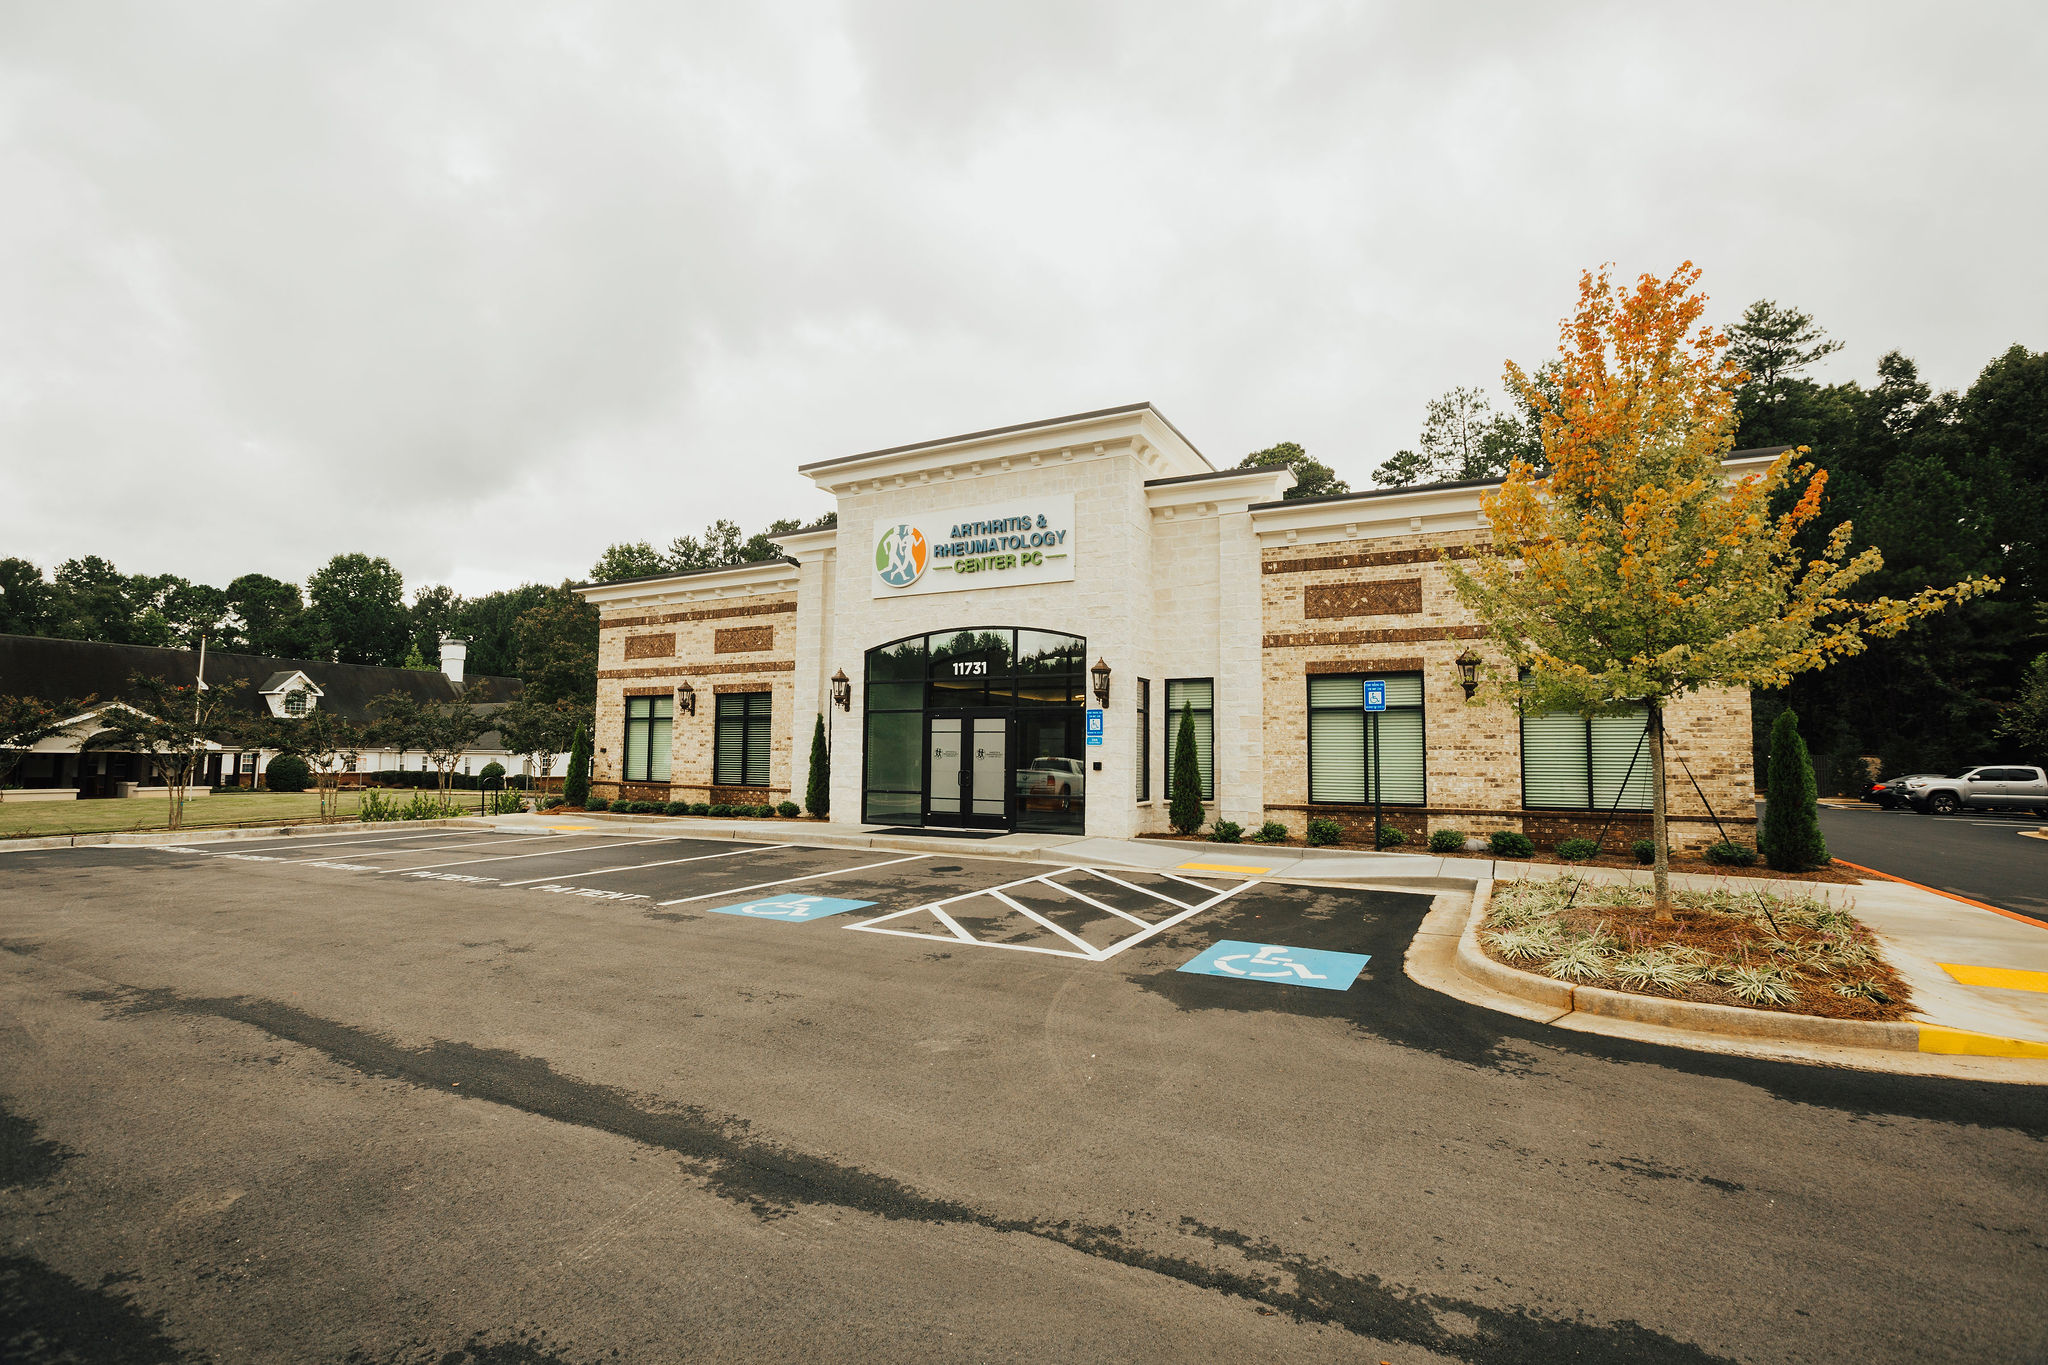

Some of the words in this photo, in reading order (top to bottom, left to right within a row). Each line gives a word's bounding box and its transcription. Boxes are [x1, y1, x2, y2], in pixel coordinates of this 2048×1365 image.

[950, 515, 1031, 538] ARTHRITIS
[1036, 514, 1048, 528] &
[934, 530, 1066, 558] RHEUMATOLOGY
[954, 554, 1016, 573] CENTER
[1021, 551, 1043, 567] PC
[953, 661, 987, 675] 11731
[528, 884, 651, 901] PATIENT
